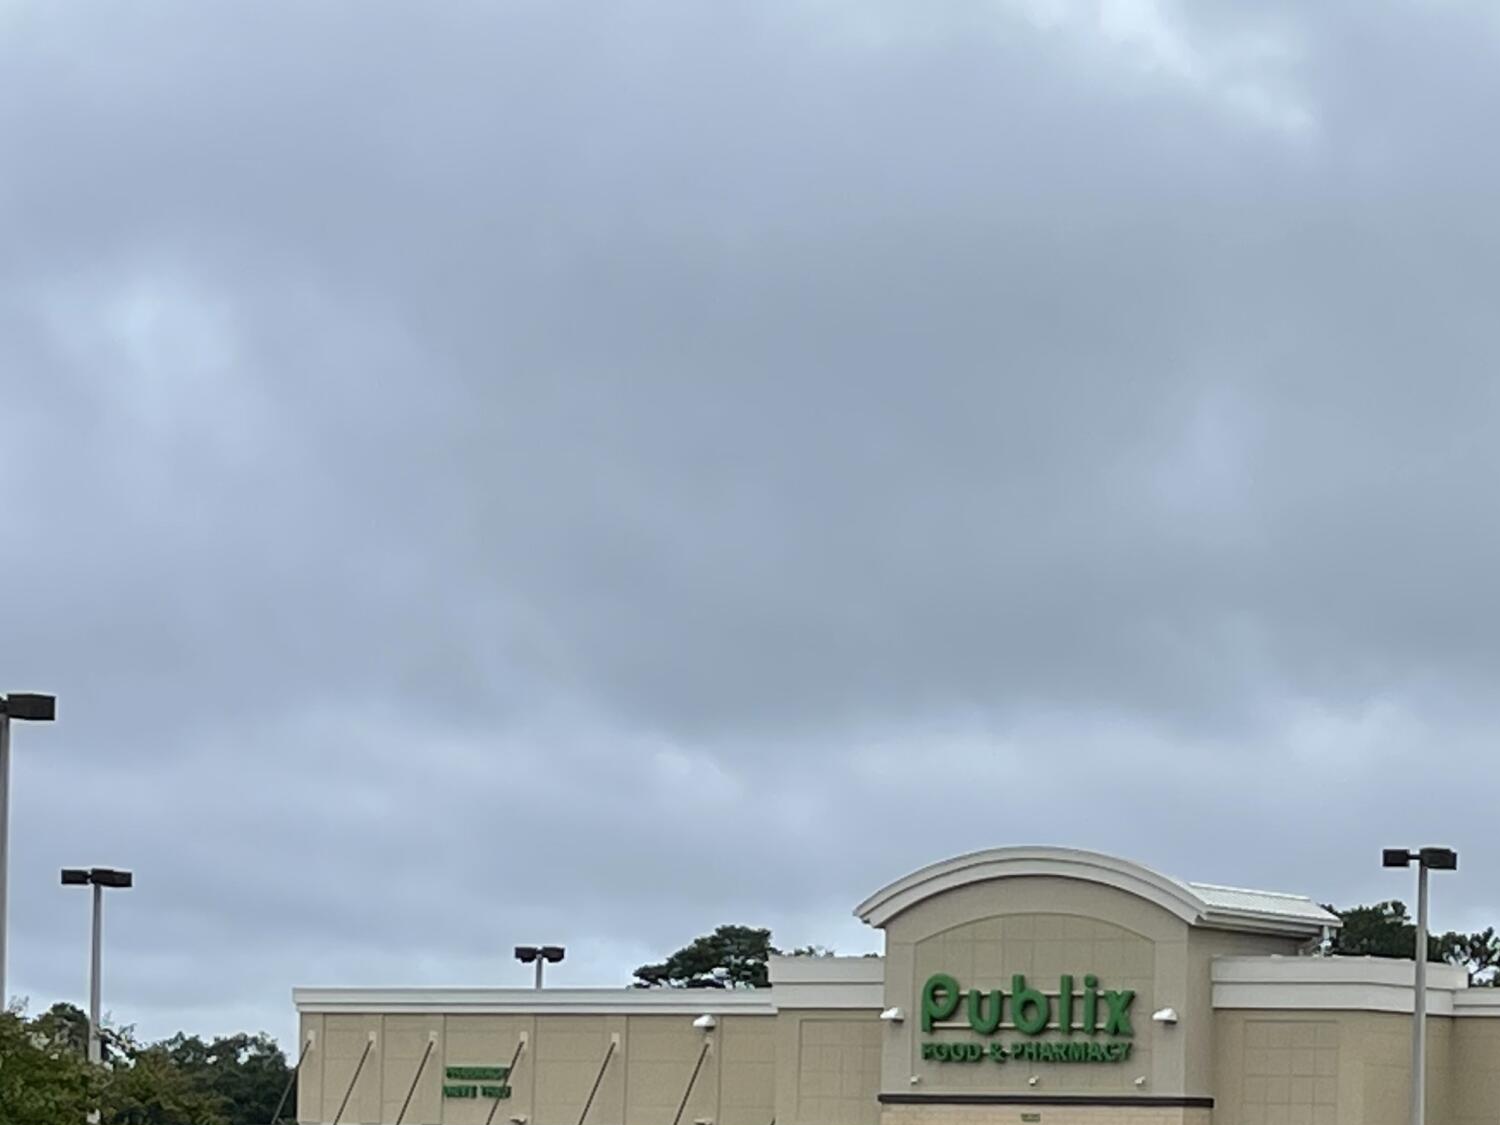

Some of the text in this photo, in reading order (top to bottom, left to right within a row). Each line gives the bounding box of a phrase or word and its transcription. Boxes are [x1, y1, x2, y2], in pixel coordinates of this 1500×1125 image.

[922, 973, 1135, 1037] Publix
[921, 1042, 1133, 1063] FOOD & PHARMACY
